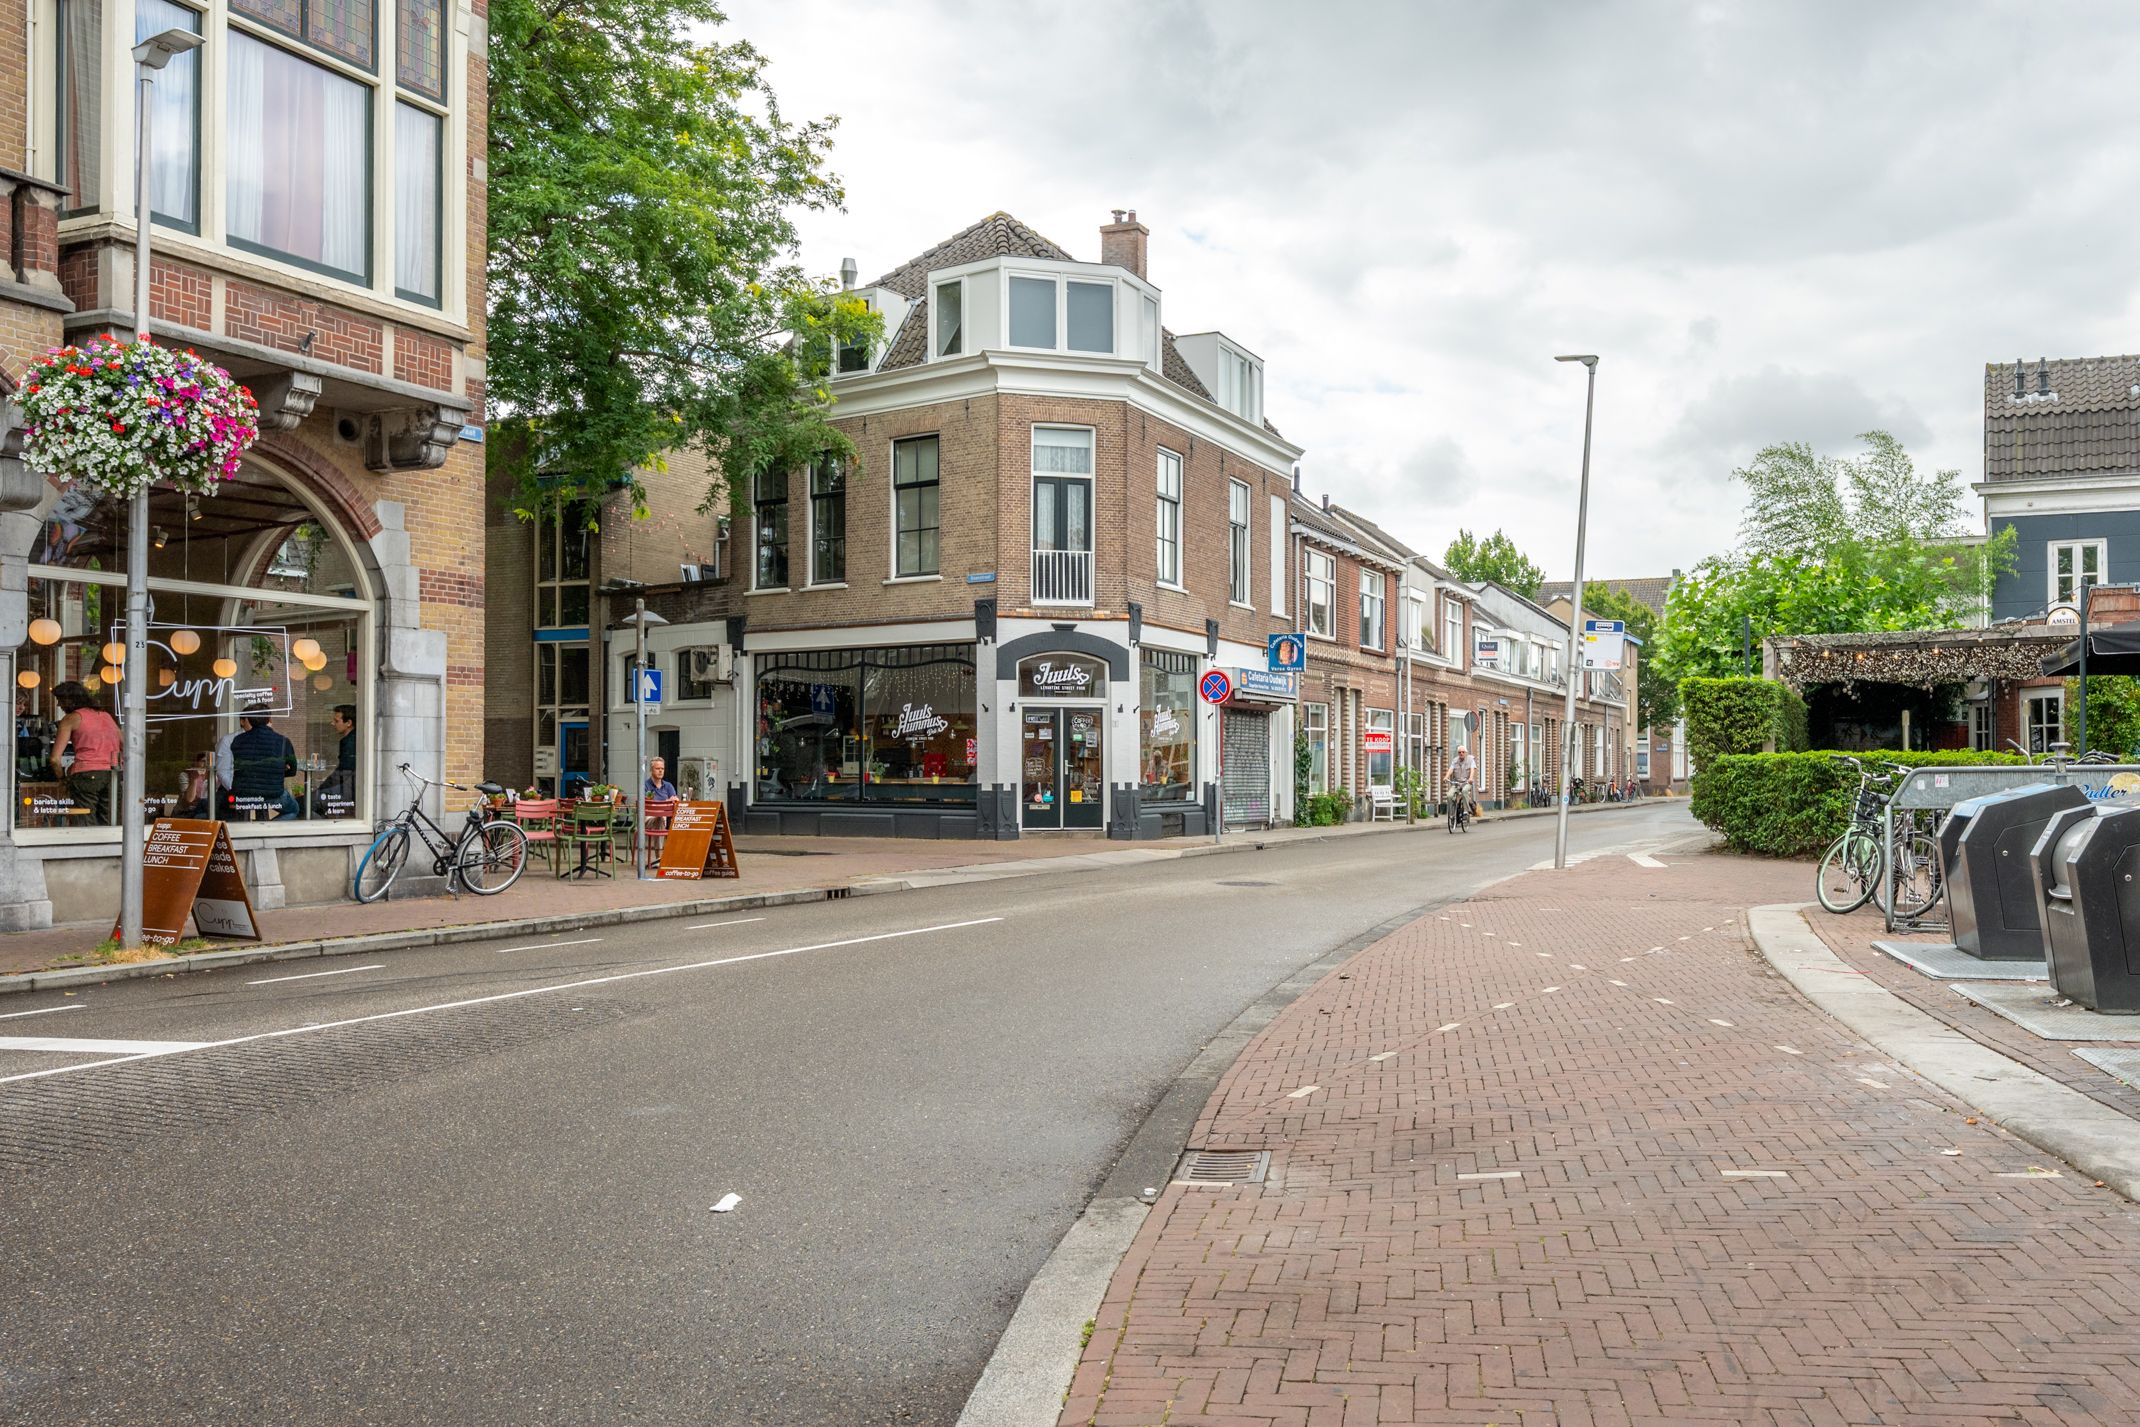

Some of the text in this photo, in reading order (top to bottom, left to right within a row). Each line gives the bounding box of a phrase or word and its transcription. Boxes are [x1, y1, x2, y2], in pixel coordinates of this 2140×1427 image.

[1033, 662, 1084, 685] Juuls
[898, 703, 933, 722] Juuls
[891, 715, 945, 738] Hummus
[152, 833, 182, 842] COFFEE
[147, 845, 189, 854] BREAKFAST
[143, 856, 169, 865] LUNCH
[209, 863, 236, 873] cakes
[142, 934, 175, 945] ee-to-go
